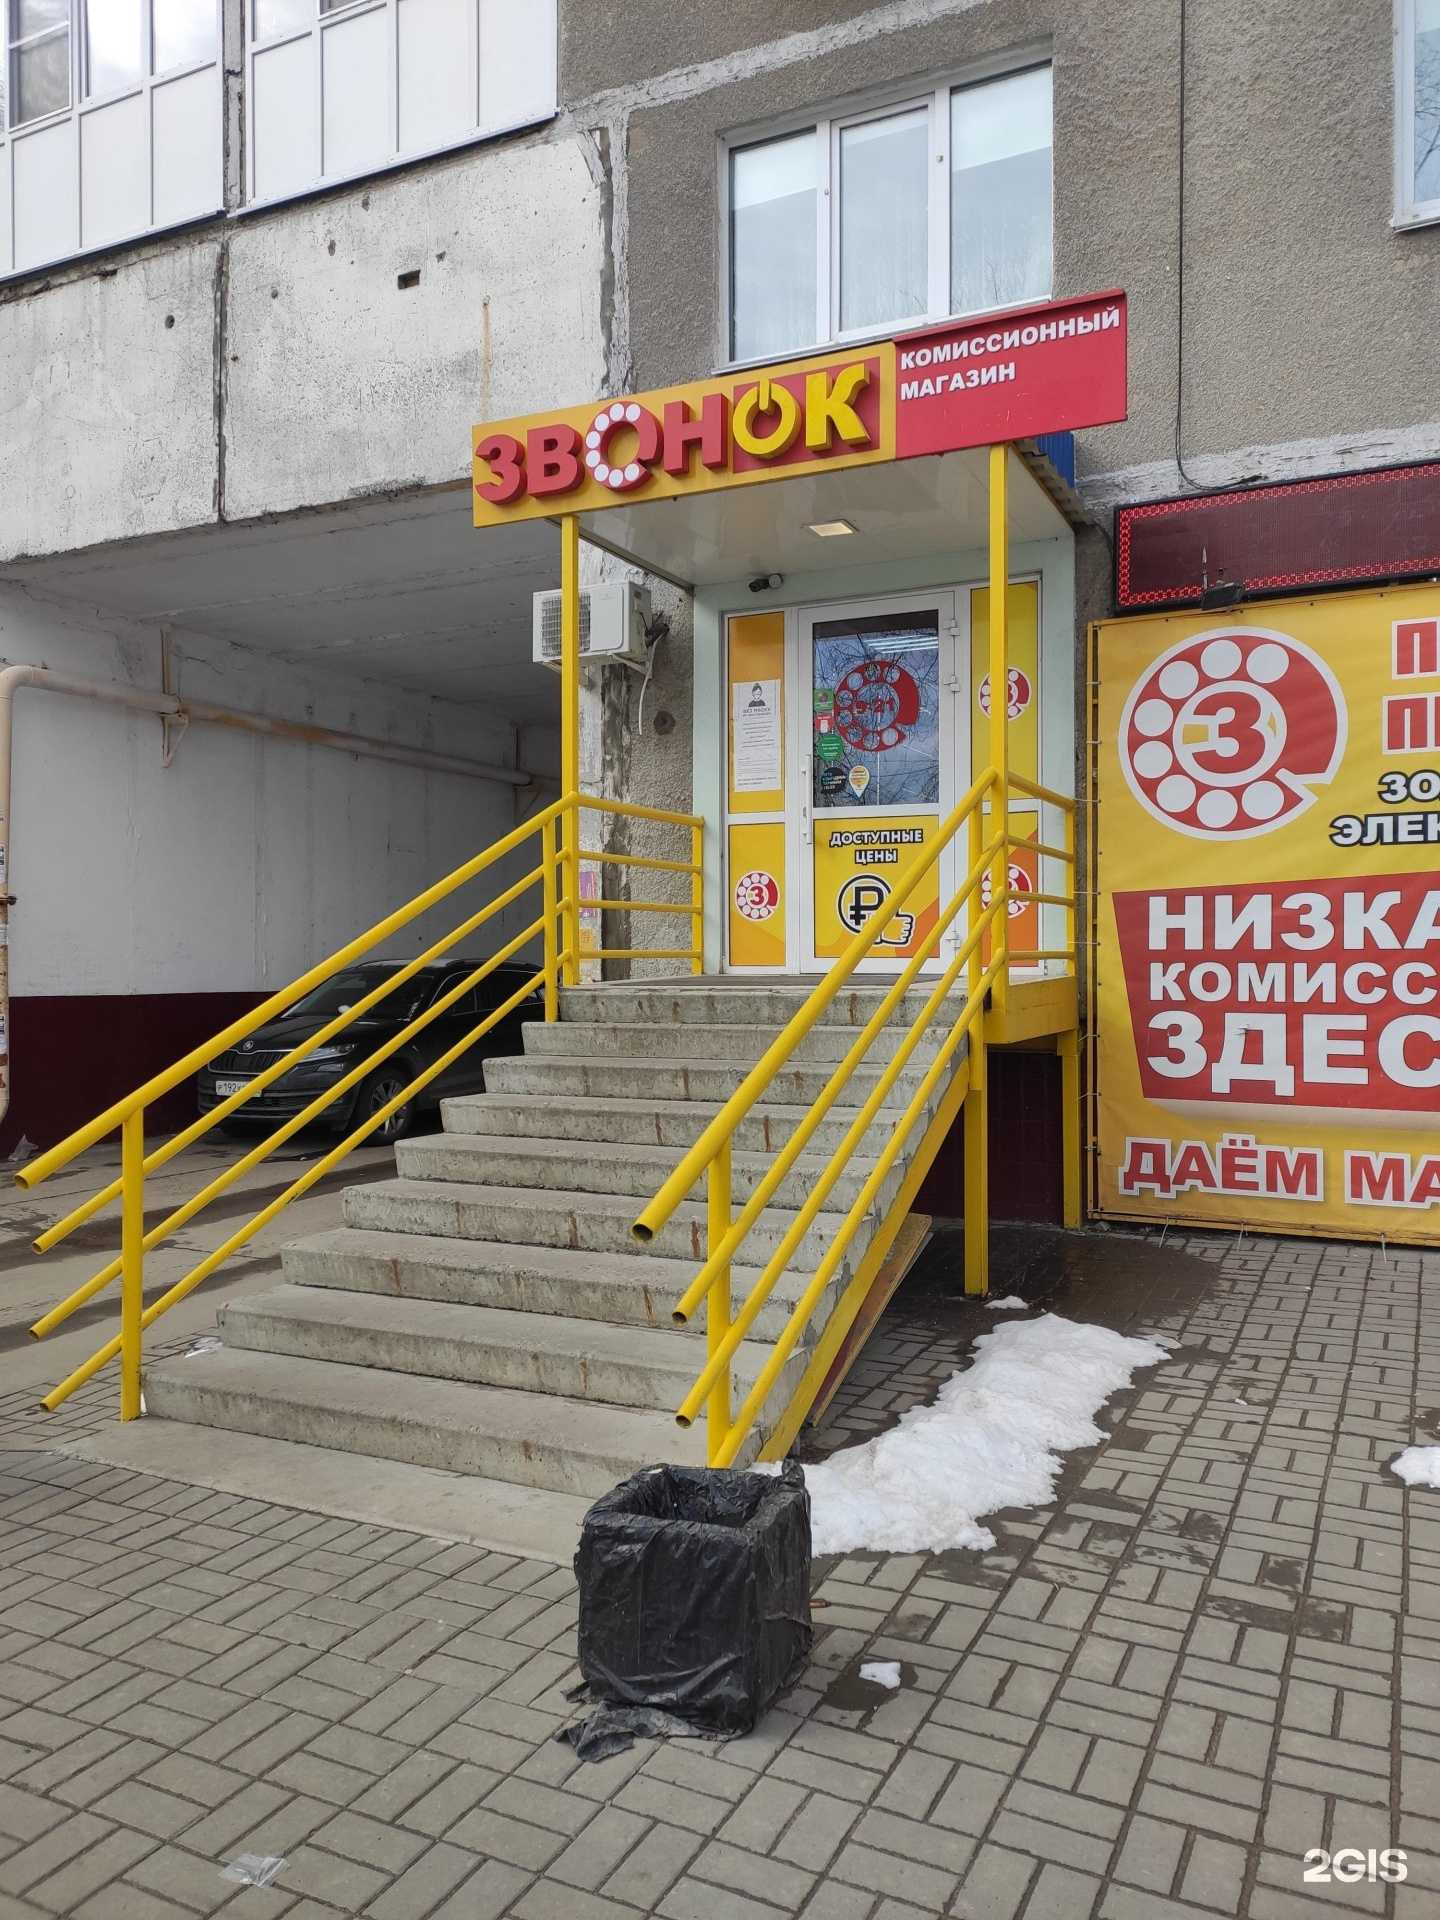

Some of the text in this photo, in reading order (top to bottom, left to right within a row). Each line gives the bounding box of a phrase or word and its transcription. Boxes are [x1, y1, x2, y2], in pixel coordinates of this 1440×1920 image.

[900, 305, 1120, 370] КОМИССИОННЫЙ
[900, 362, 1016, 401] МАГАЗИН
[475, 362, 870, 504] ЗВОНОК
[1383, 692, 1440, 755] П
[829, 828, 924, 847] ДОСТУПНЫЕ
[855, 848, 898, 865] ЦЕНЫ
[1148, 890, 1440, 951] НИЗКА
[1149, 961, 1438, 1005] КОМИСС
[1147, 1009, 1440, 1097] ЗДЕС
[1120, 1133, 1440, 1208] ДАЁМ МА
